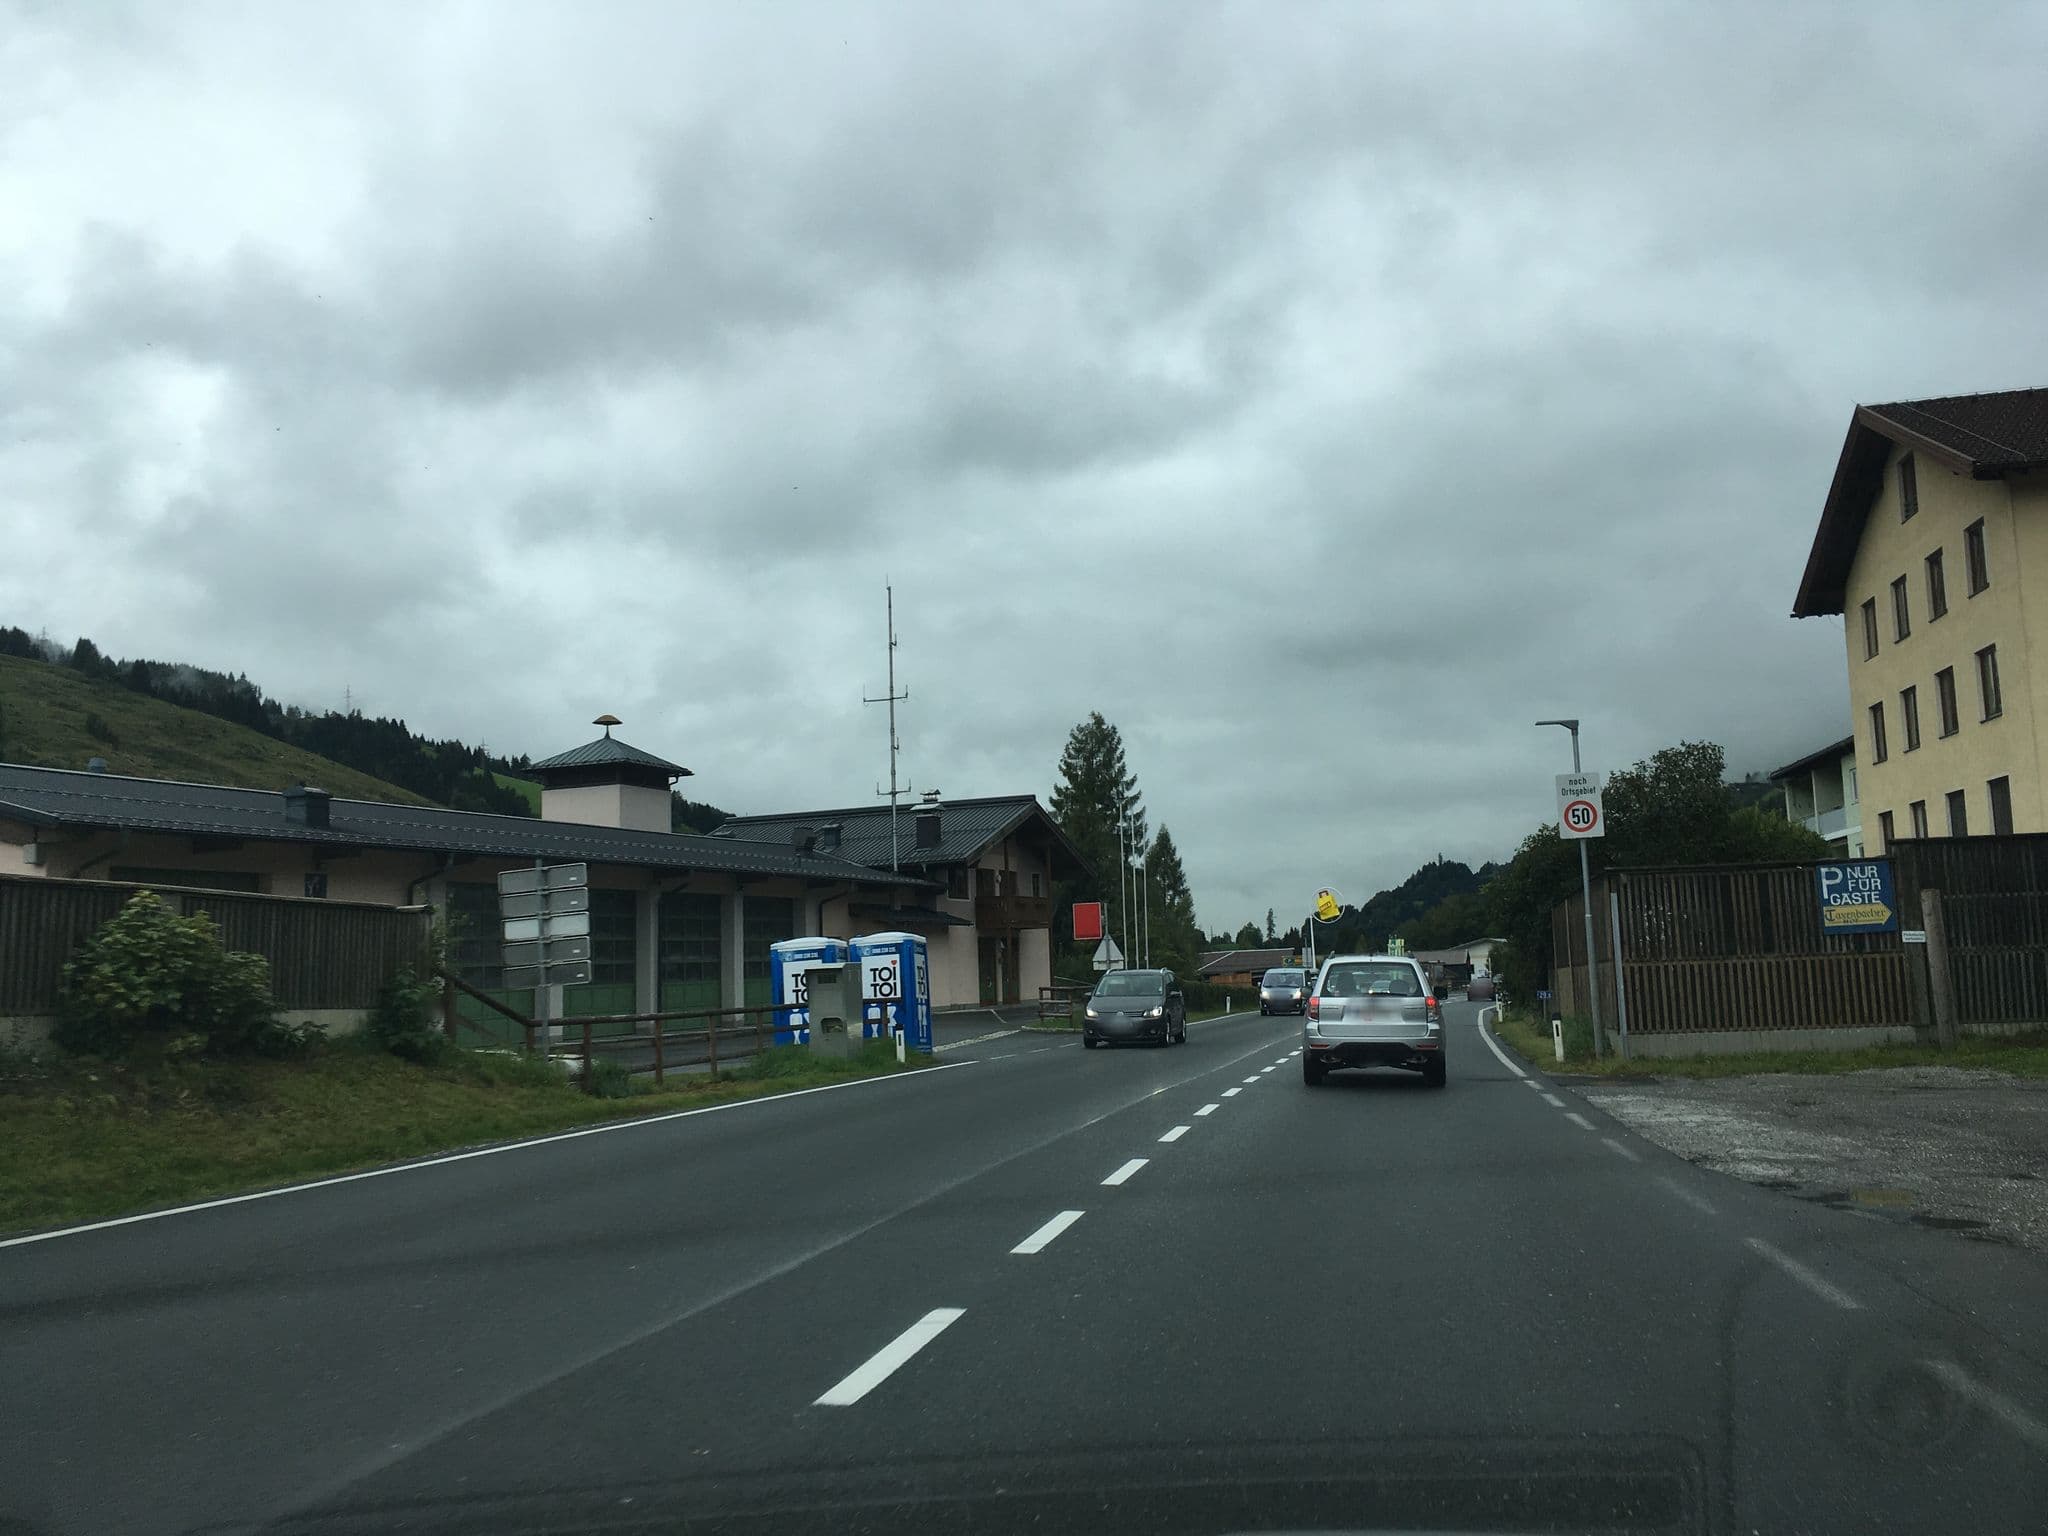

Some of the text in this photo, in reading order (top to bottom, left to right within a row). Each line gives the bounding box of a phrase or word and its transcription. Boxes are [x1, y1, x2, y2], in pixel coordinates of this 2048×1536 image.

[1568, 777, 1587, 785] noch
[1561, 786, 1596, 797] Ortsgebiet
[1571, 807, 1591, 825] 50
[1846, 865, 1879, 879] NUR
[1820, 867, 1844, 899] P
[1848, 877, 1881, 891] FÜR
[1830, 891, 1881, 906] GÄSTE
[869, 966, 897, 982] TOI
[870, 982, 898, 998] TOI
